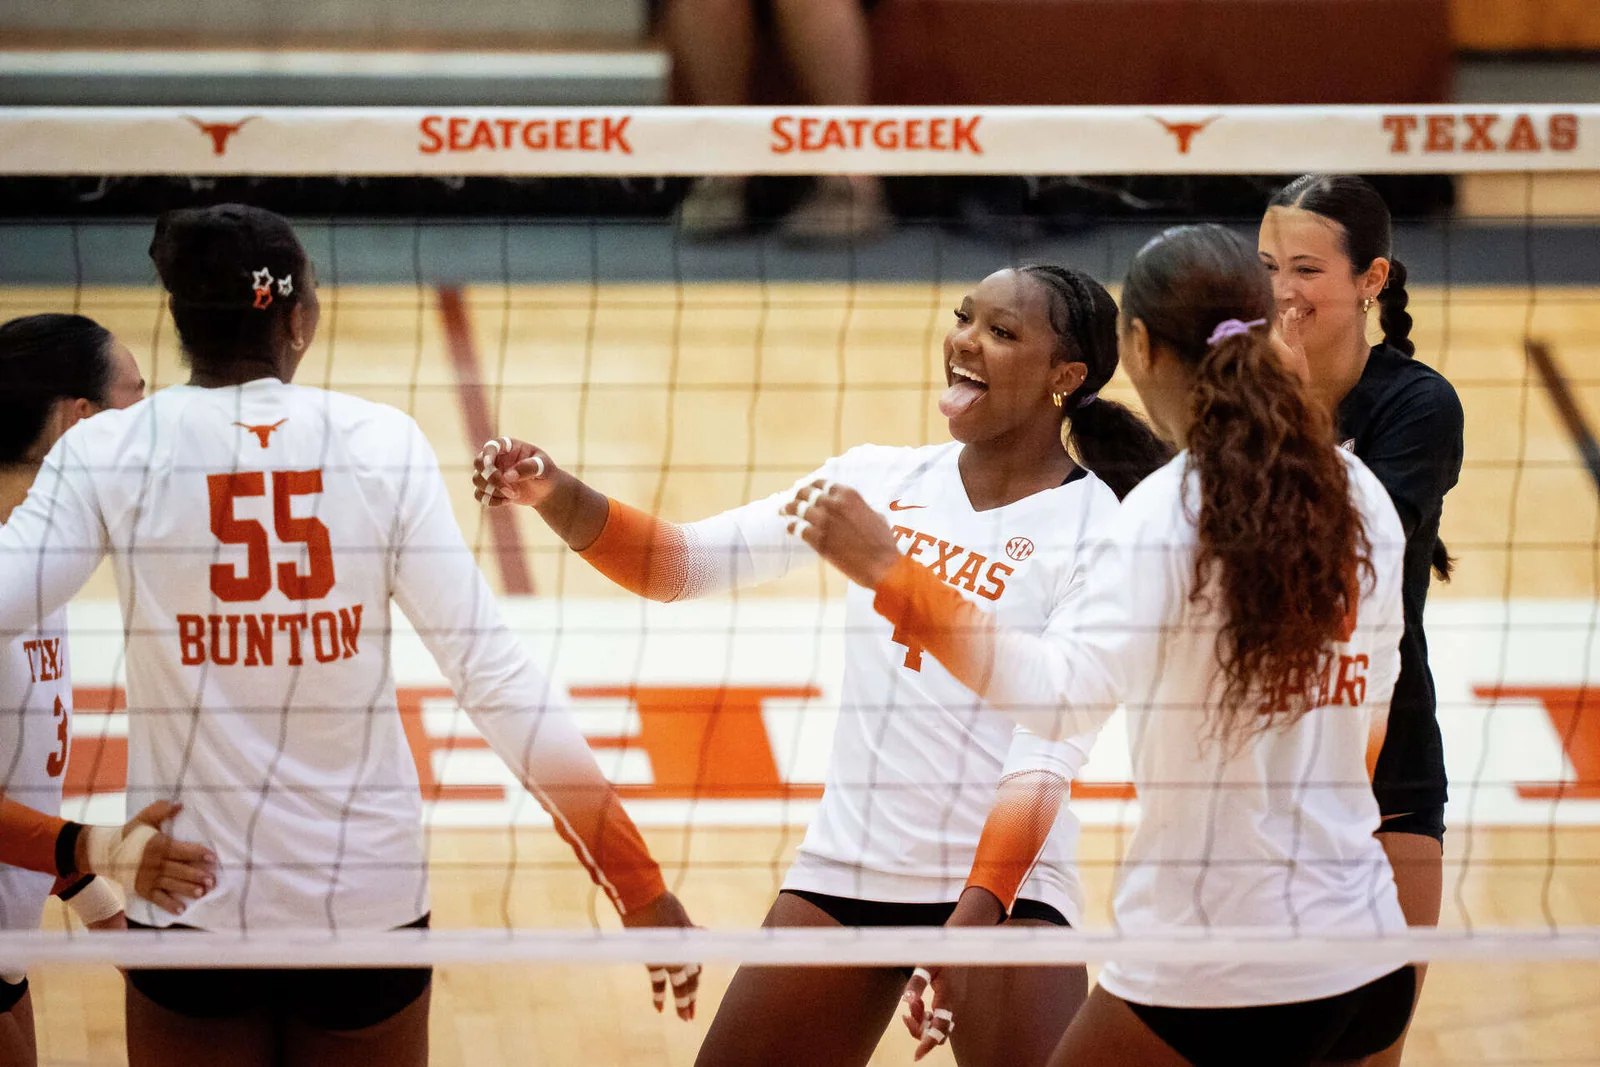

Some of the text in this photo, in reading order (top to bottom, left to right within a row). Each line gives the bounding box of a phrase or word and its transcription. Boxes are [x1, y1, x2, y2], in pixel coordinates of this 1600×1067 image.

[419, 115, 632, 155] SEATGEEK
[770, 115, 983, 155] SEATGEEK
[1382, 113, 1579, 153] TEXAS
[206, 469, 336, 602] 55
[176, 604, 364, 667] BUNTON
[23, 637, 64, 683] TEX
[46, 693, 68, 777] 3
